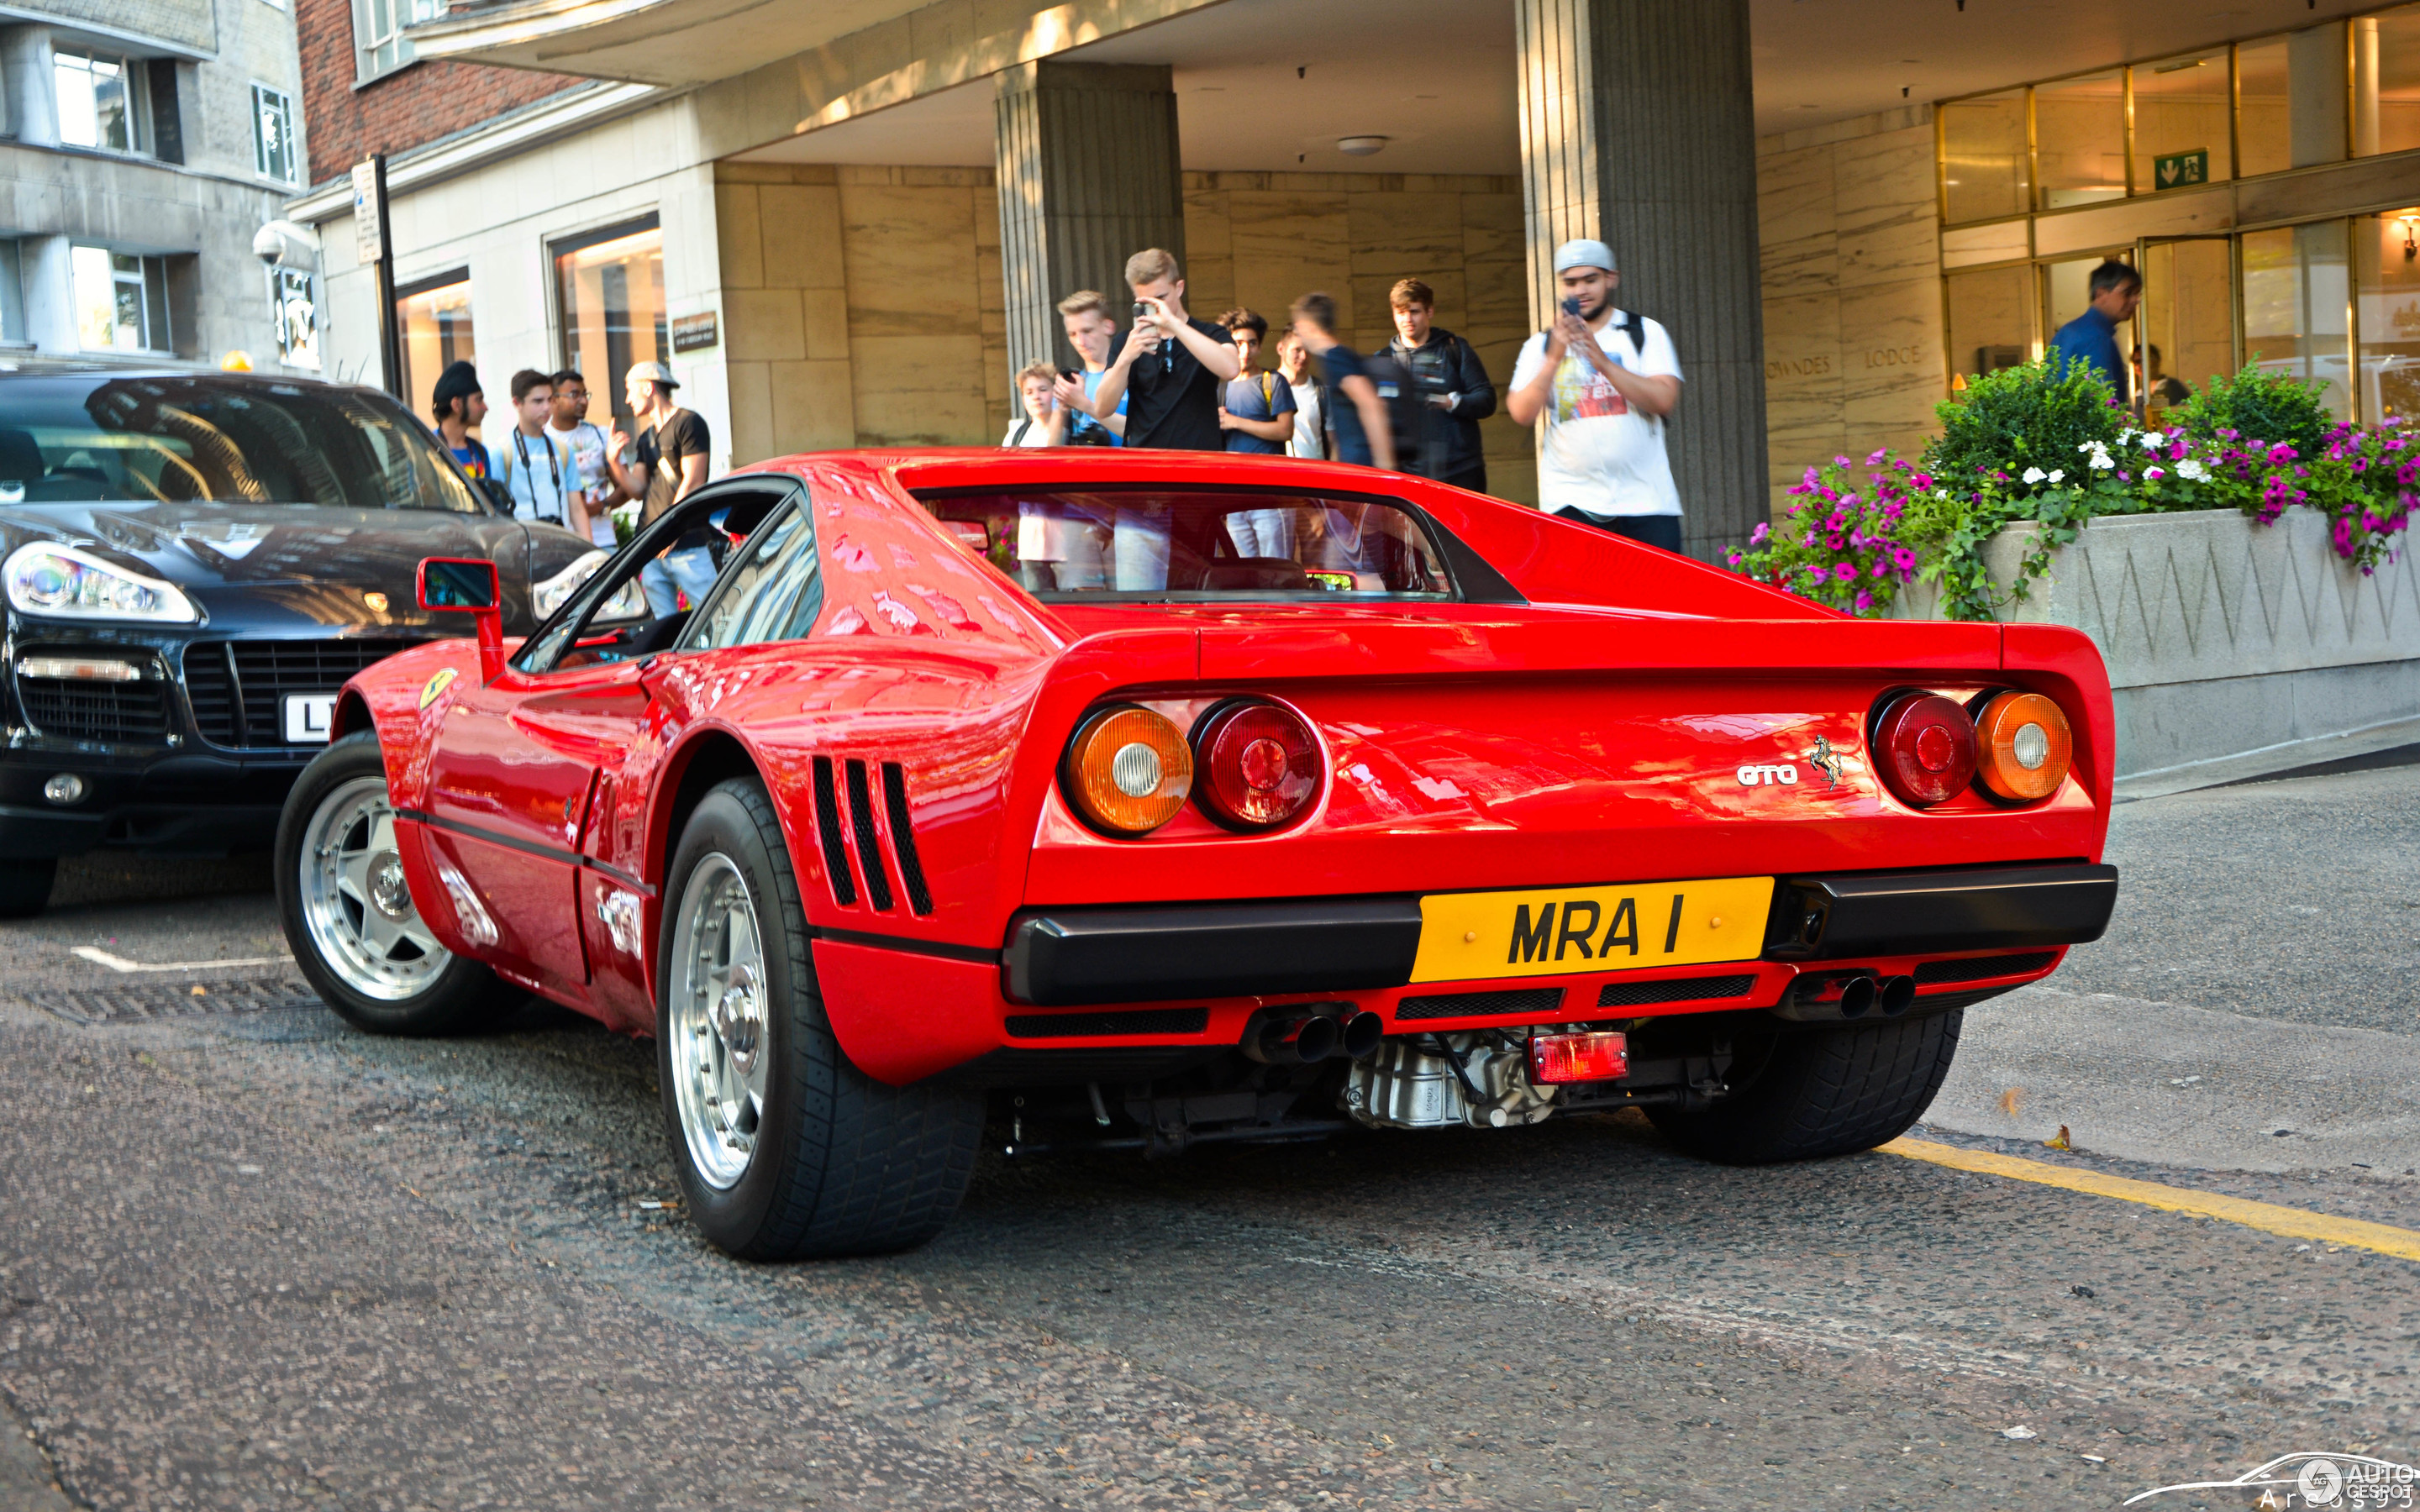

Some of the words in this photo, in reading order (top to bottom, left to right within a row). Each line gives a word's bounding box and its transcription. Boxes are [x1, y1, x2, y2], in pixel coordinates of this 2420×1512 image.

[1765, 356, 1830, 379] OWNDES
[1865, 345, 1922, 369] LODGE
[304, 702, 336, 732] L
[1737, 764, 1798, 786] GTO
[1507, 898, 1639, 963] MRA
